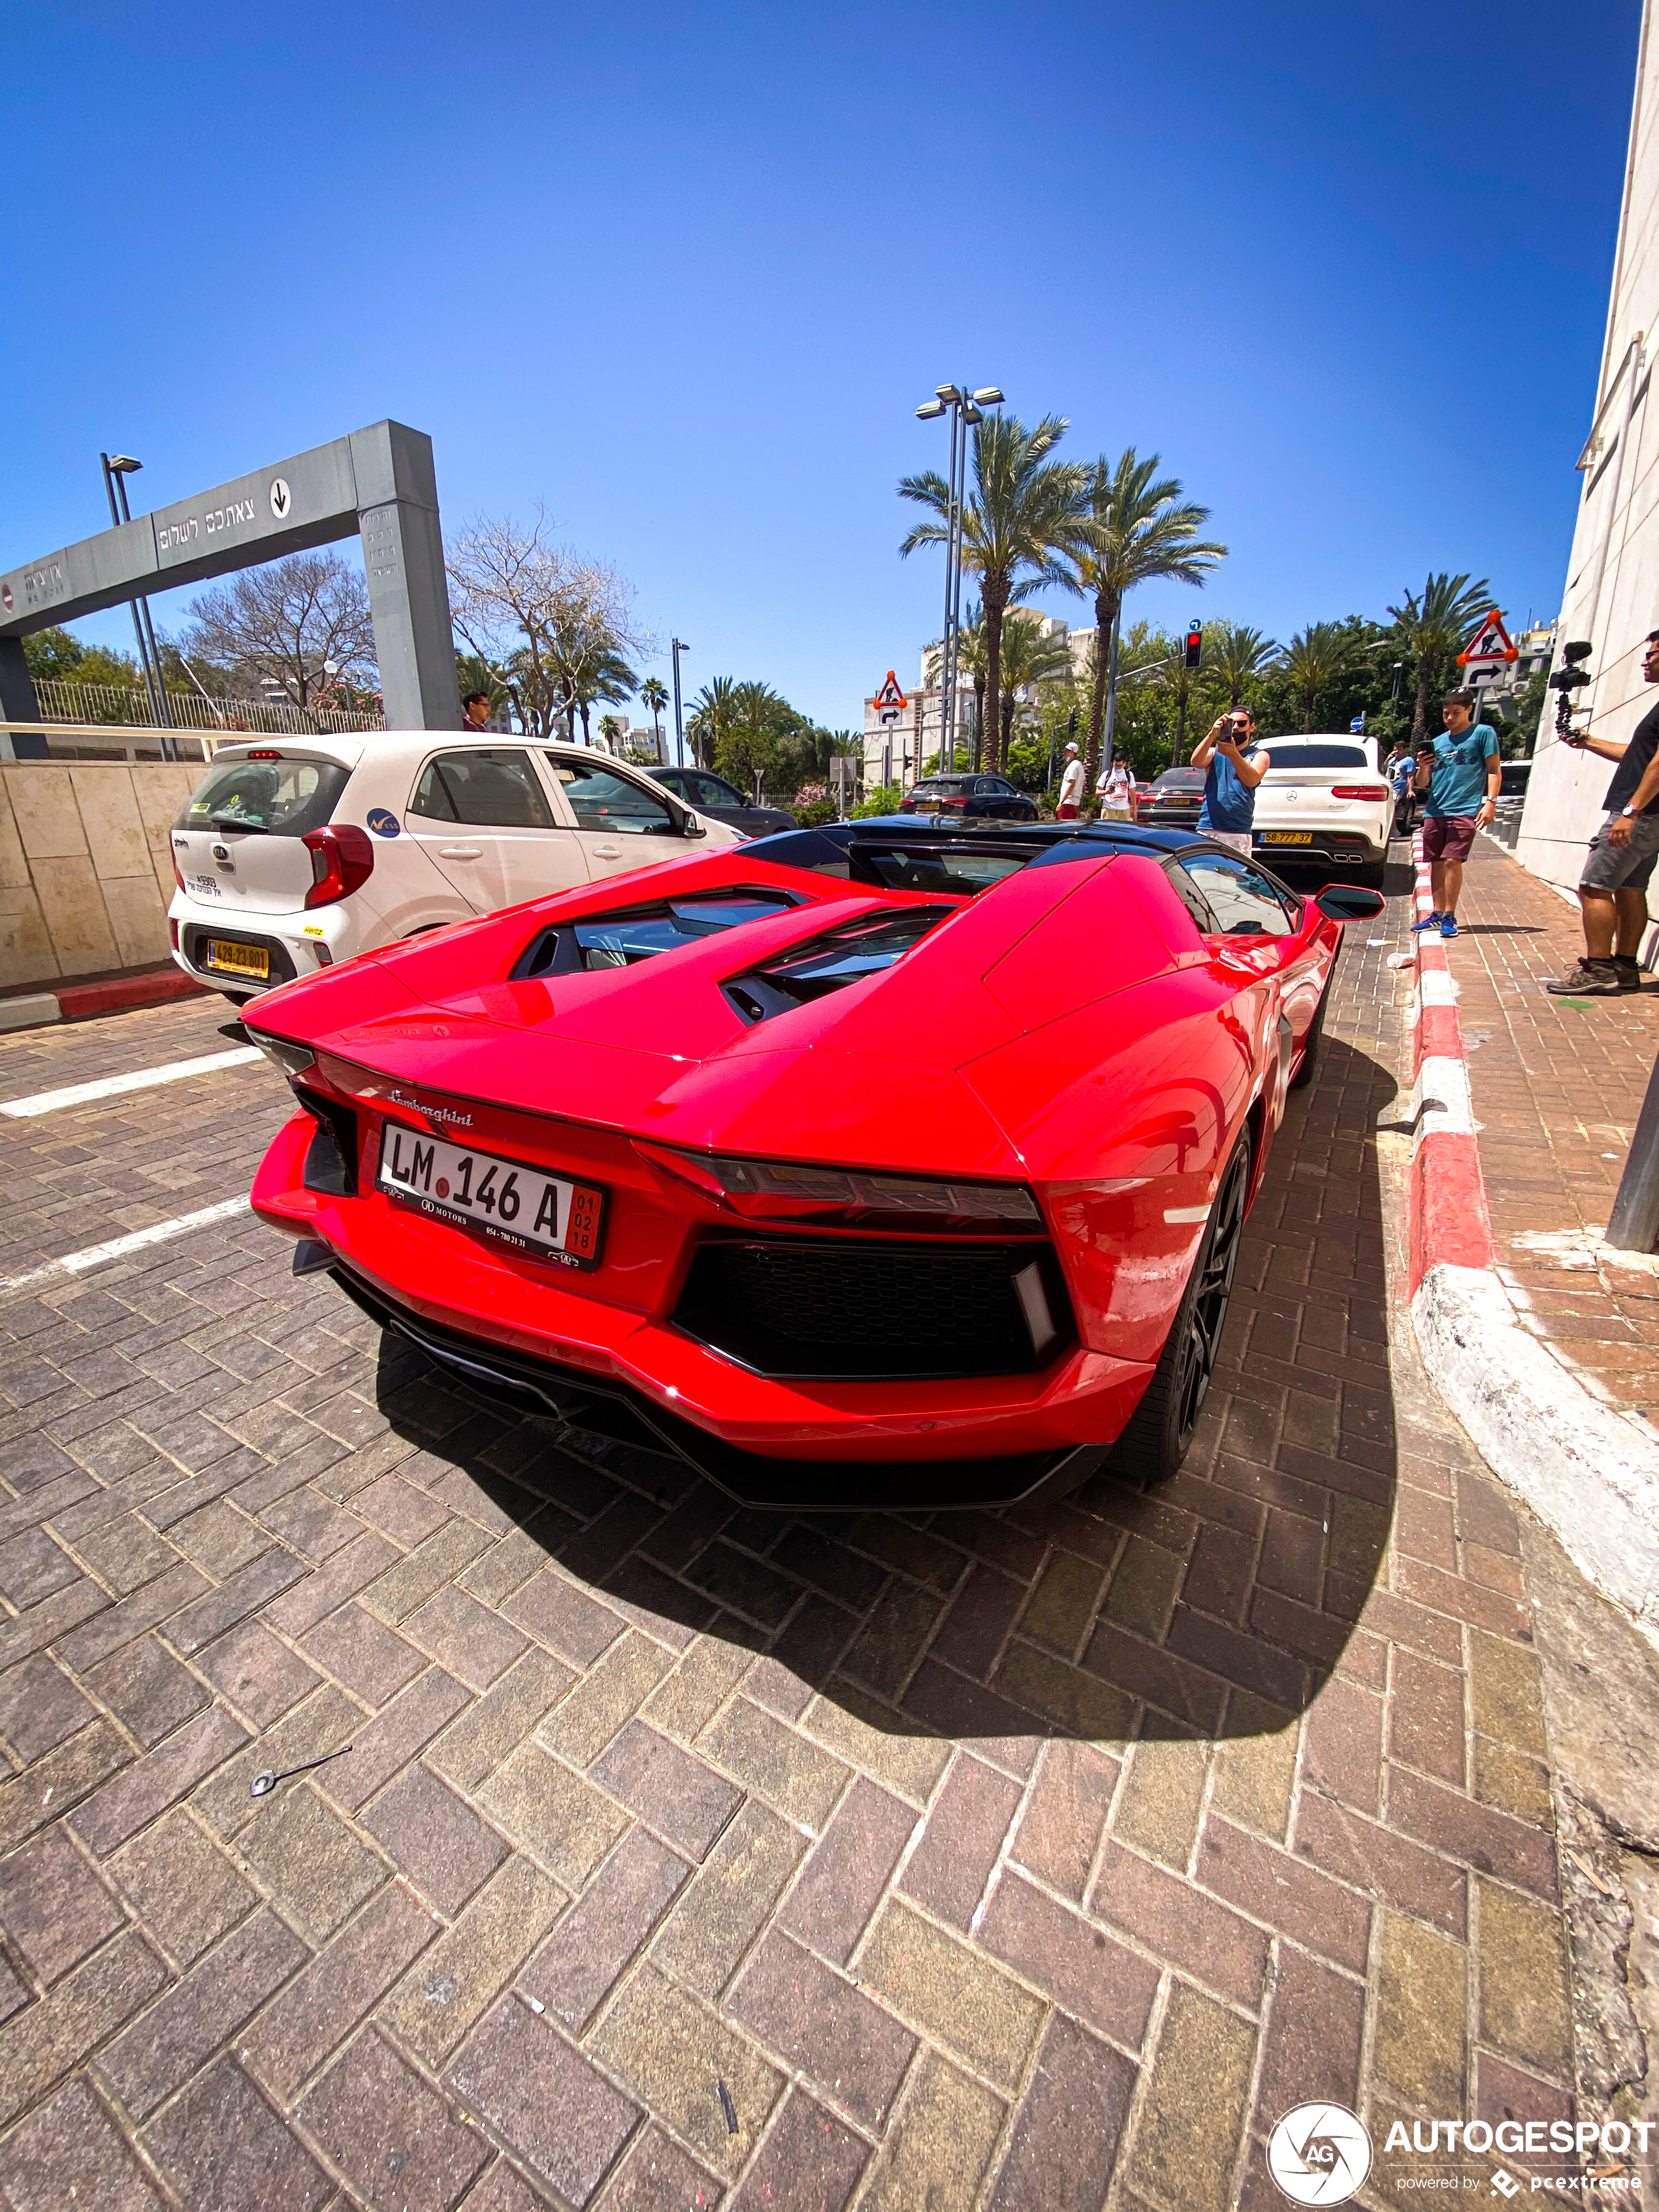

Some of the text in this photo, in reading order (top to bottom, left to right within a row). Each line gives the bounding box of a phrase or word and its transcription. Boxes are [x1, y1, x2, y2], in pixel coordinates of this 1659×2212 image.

[159, 498, 255, 549] צאתכם לשלום
[304, 927, 323, 936] Hertz
[387, 1089, 474, 1126] Lamborghini
[392, 1134, 557, 1238] LM 146 A
[421, 1199, 467, 1225] GD MOTORS
[577, 1194, 593, 1213] 01
[575, 1213, 591, 1231] 02
[573, 1232, 588, 1249] 18
